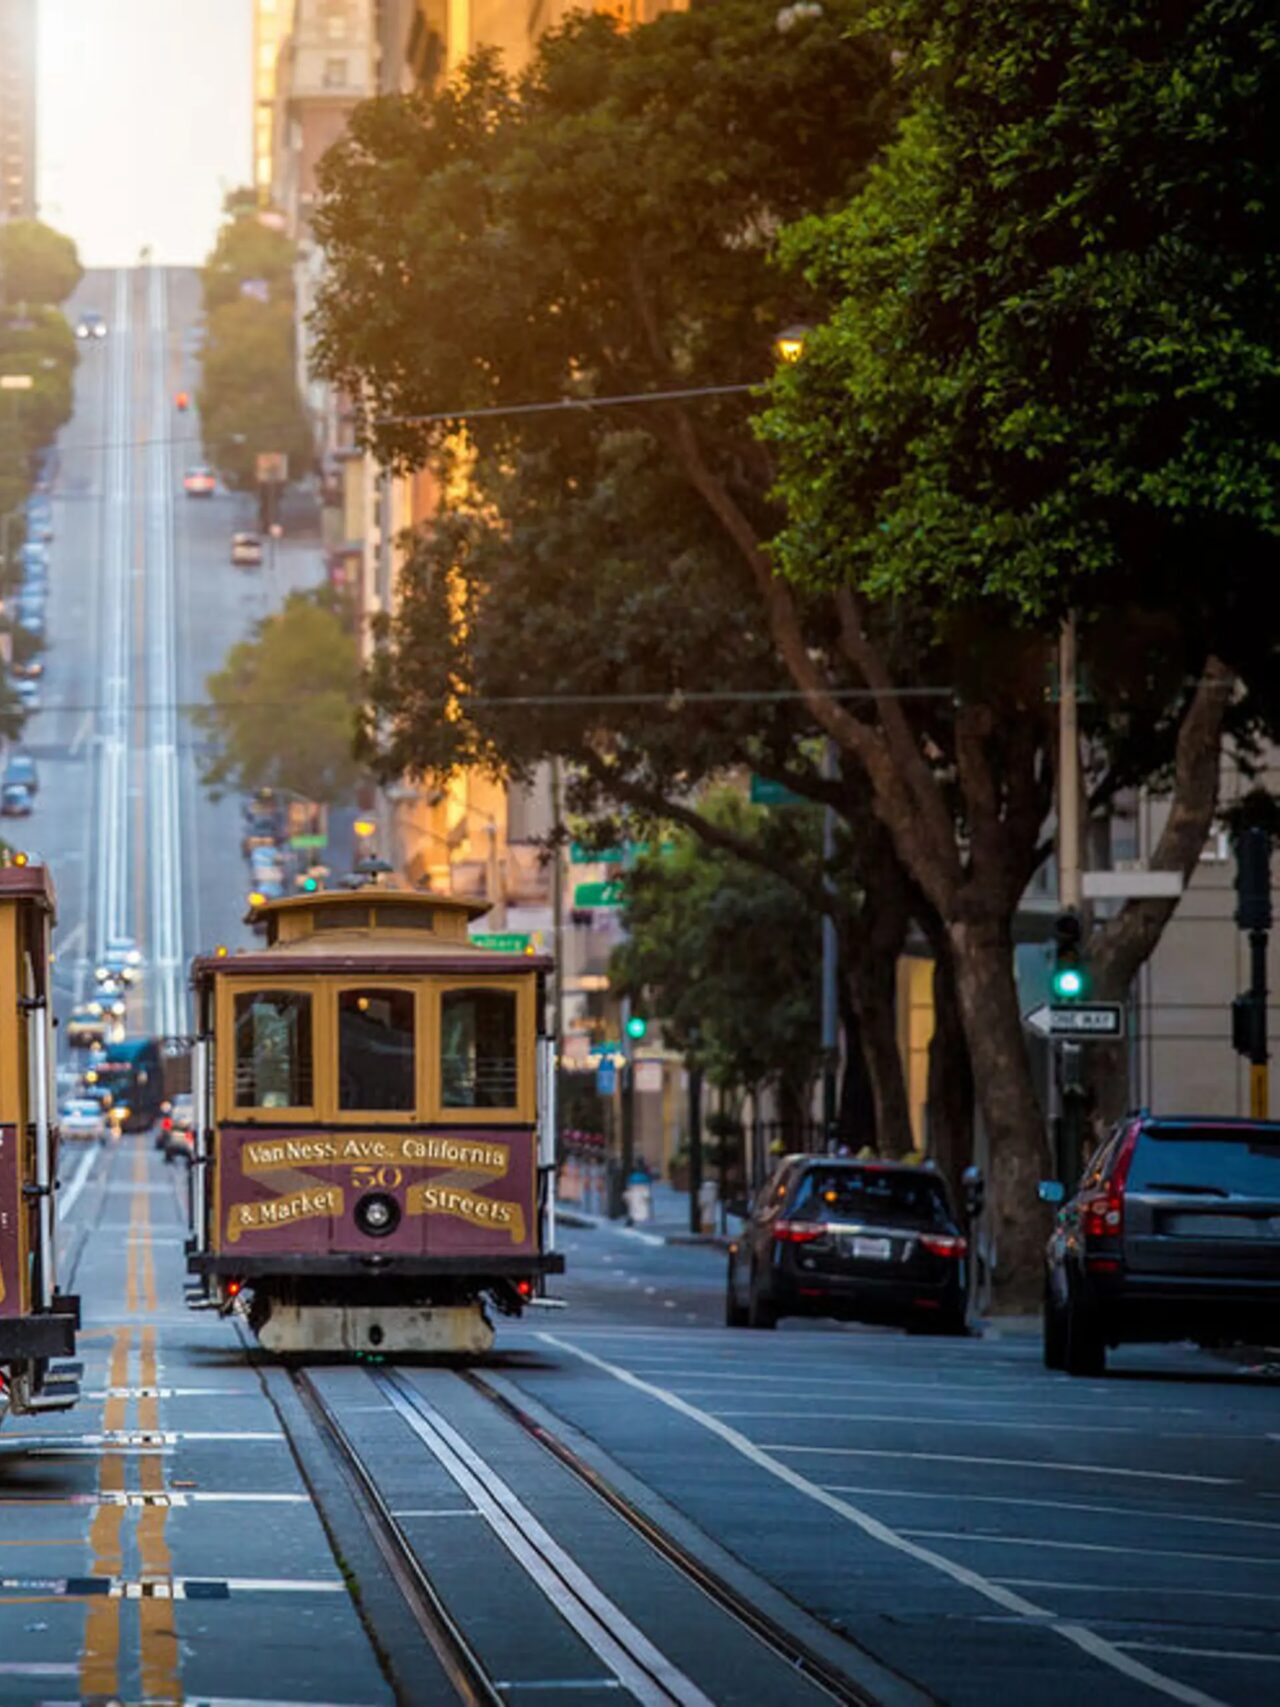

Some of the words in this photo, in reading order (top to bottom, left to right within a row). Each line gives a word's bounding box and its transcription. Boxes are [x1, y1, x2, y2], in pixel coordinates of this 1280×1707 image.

[248, 1145, 284, 1163] Van
[286, 1141, 338, 1160] Ness
[402, 1139, 505, 1166] California
[240, 1205, 255, 1225] &
[259, 1191, 334, 1222] Market
[424, 1189, 512, 1222] Streets
